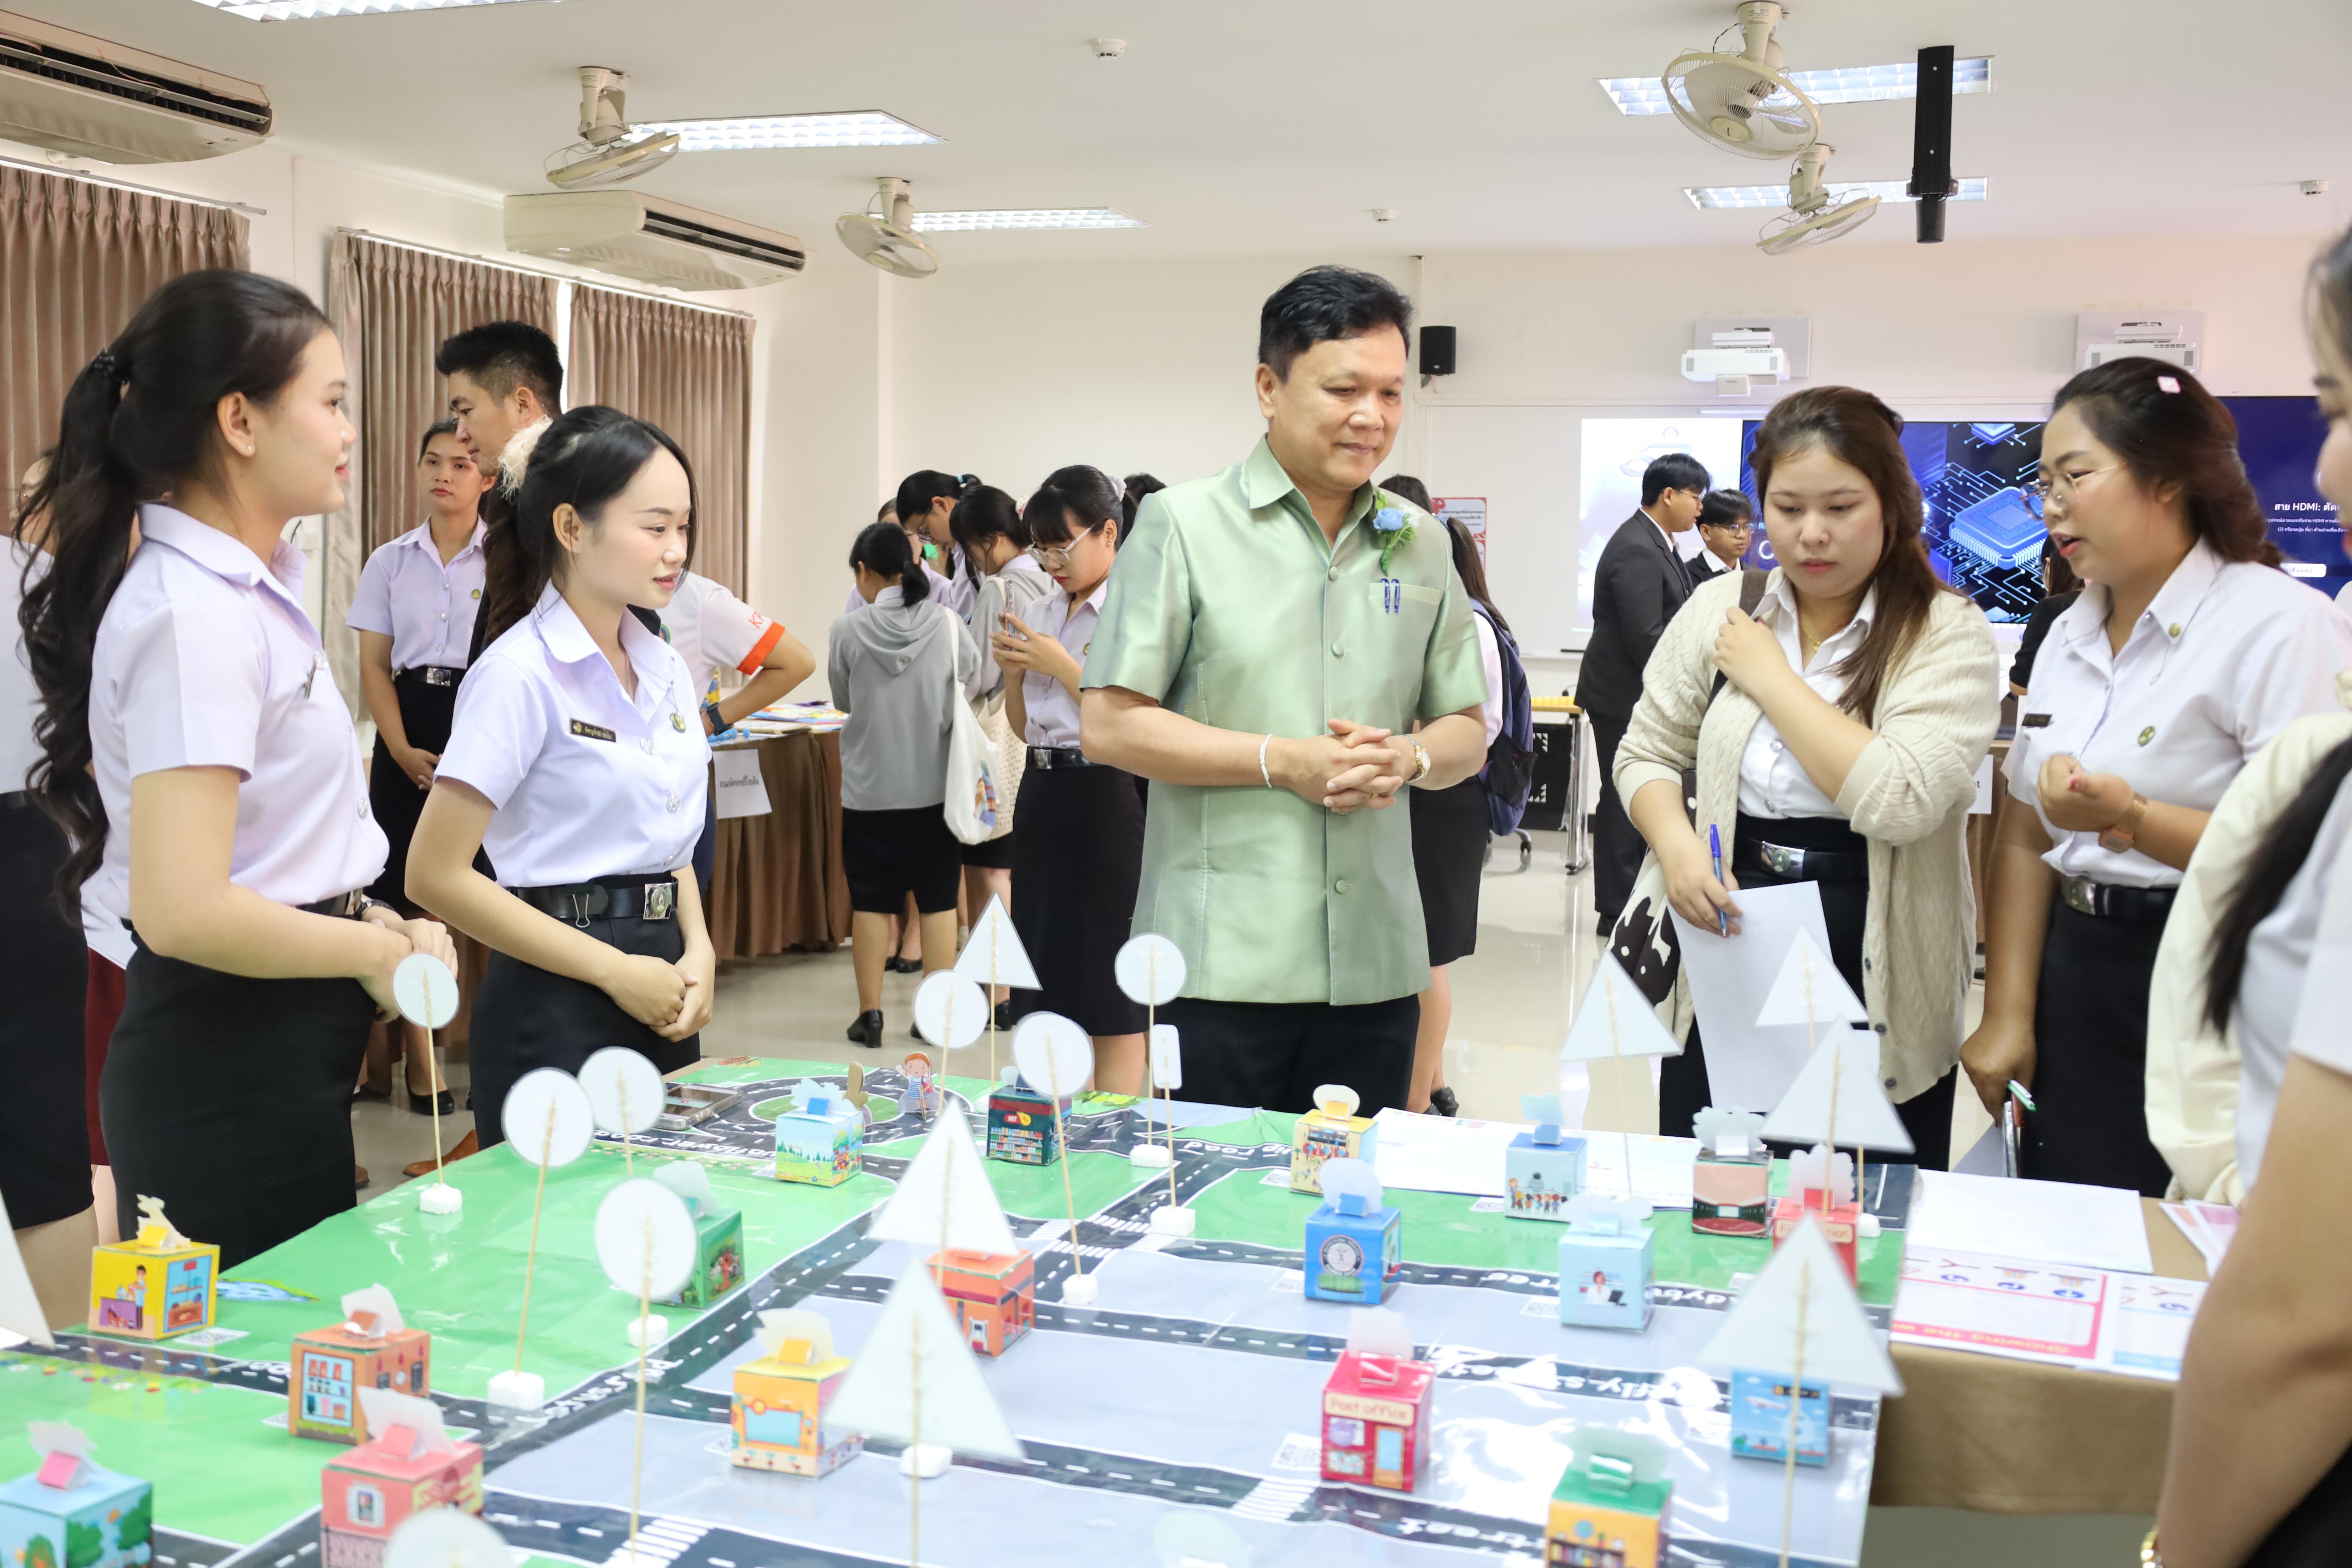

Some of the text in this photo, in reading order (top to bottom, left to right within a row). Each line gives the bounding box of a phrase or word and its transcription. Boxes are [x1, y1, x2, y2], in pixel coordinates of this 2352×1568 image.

[662, 1137, 776, 1158] unflower
[1184, 1141, 1292, 1156] lip road
[1331, 1397, 1407, 1419] Post office
